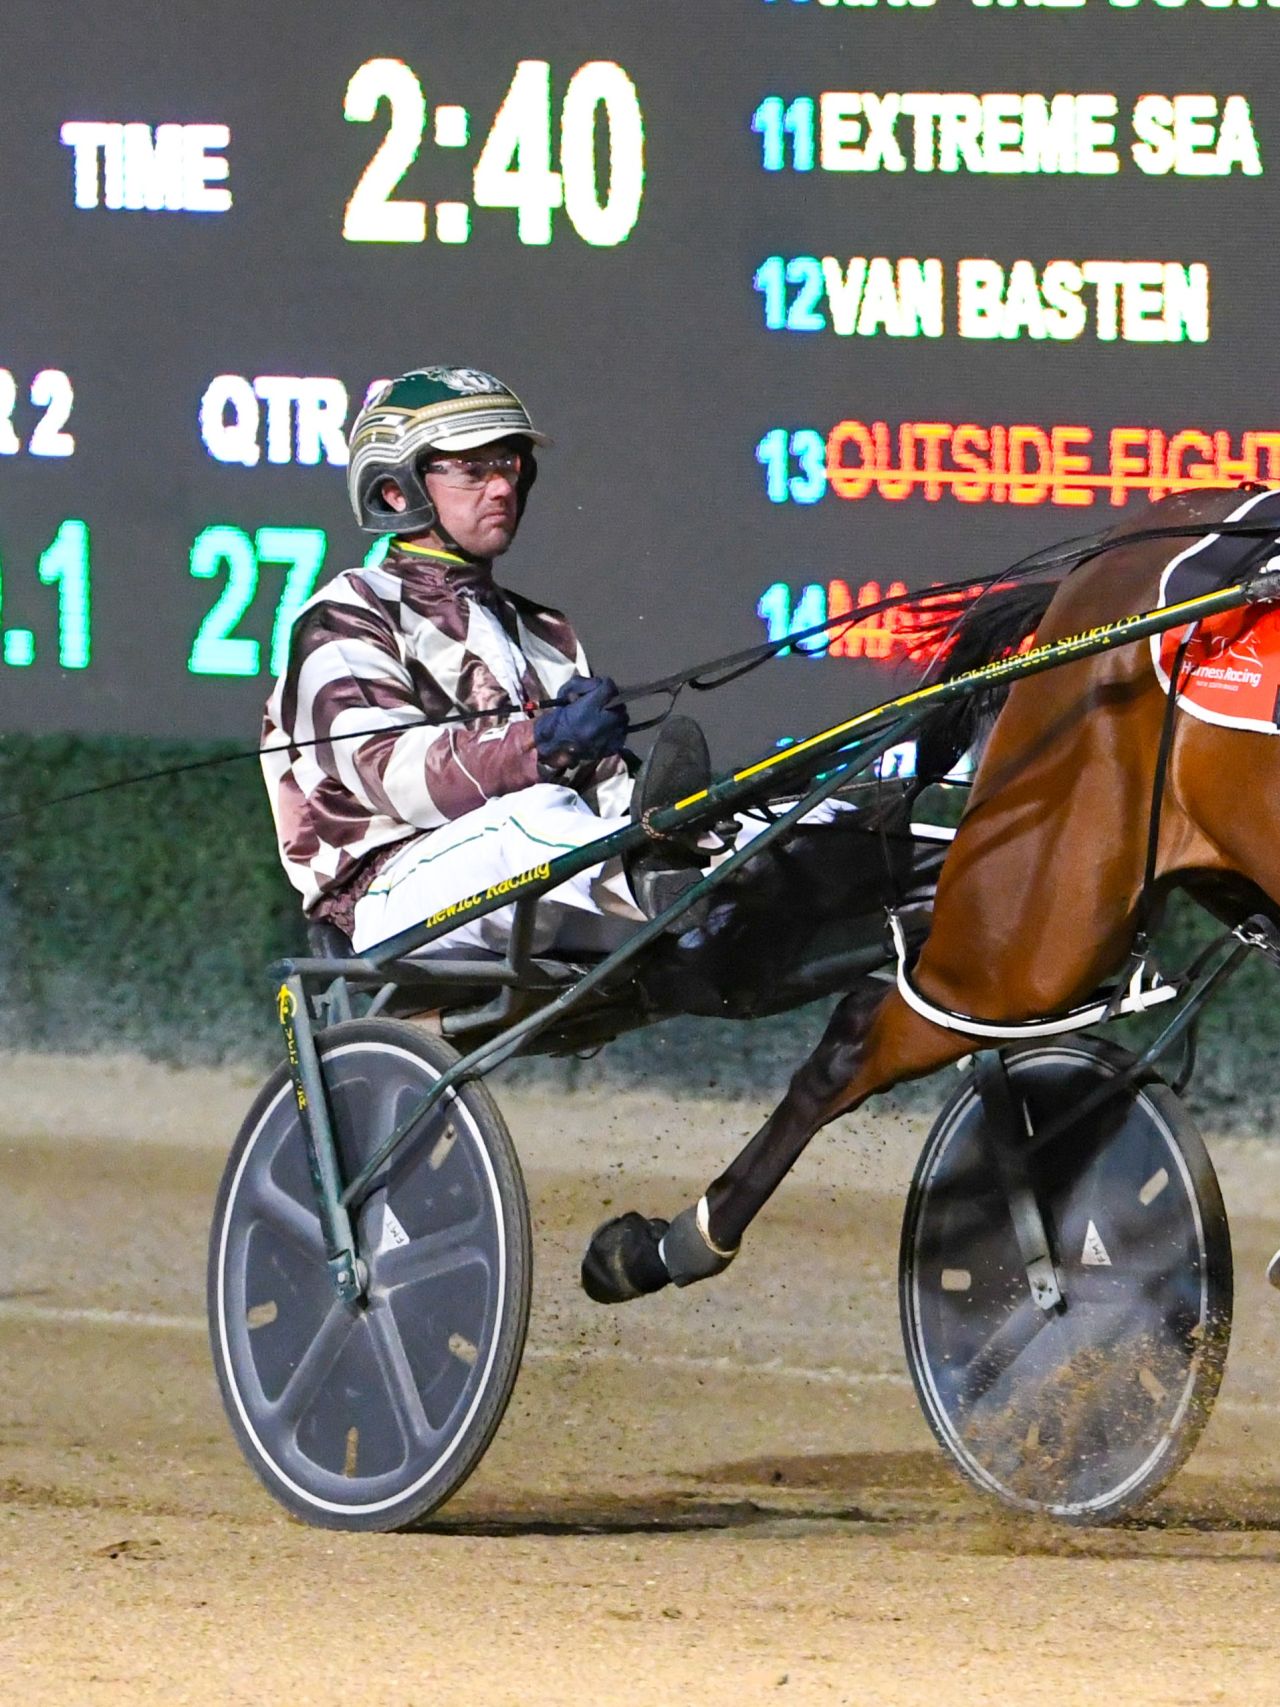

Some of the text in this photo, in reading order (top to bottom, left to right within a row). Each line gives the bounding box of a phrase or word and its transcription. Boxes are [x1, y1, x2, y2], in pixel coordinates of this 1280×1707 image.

[60, 58, 645, 246] TIME 2:40
[751, 92, 1263, 176] 11 EXTREME SEA
[753, 256, 1209, 342] 12 VAN BASTEN
[198, 375, 350, 467] QTR
[755, 428, 828, 504] 13
[826, 420, 1094, 506] OUTSIDE
[757, 580, 829, 659] 14
[1224, 666, 1262, 688] Racing
